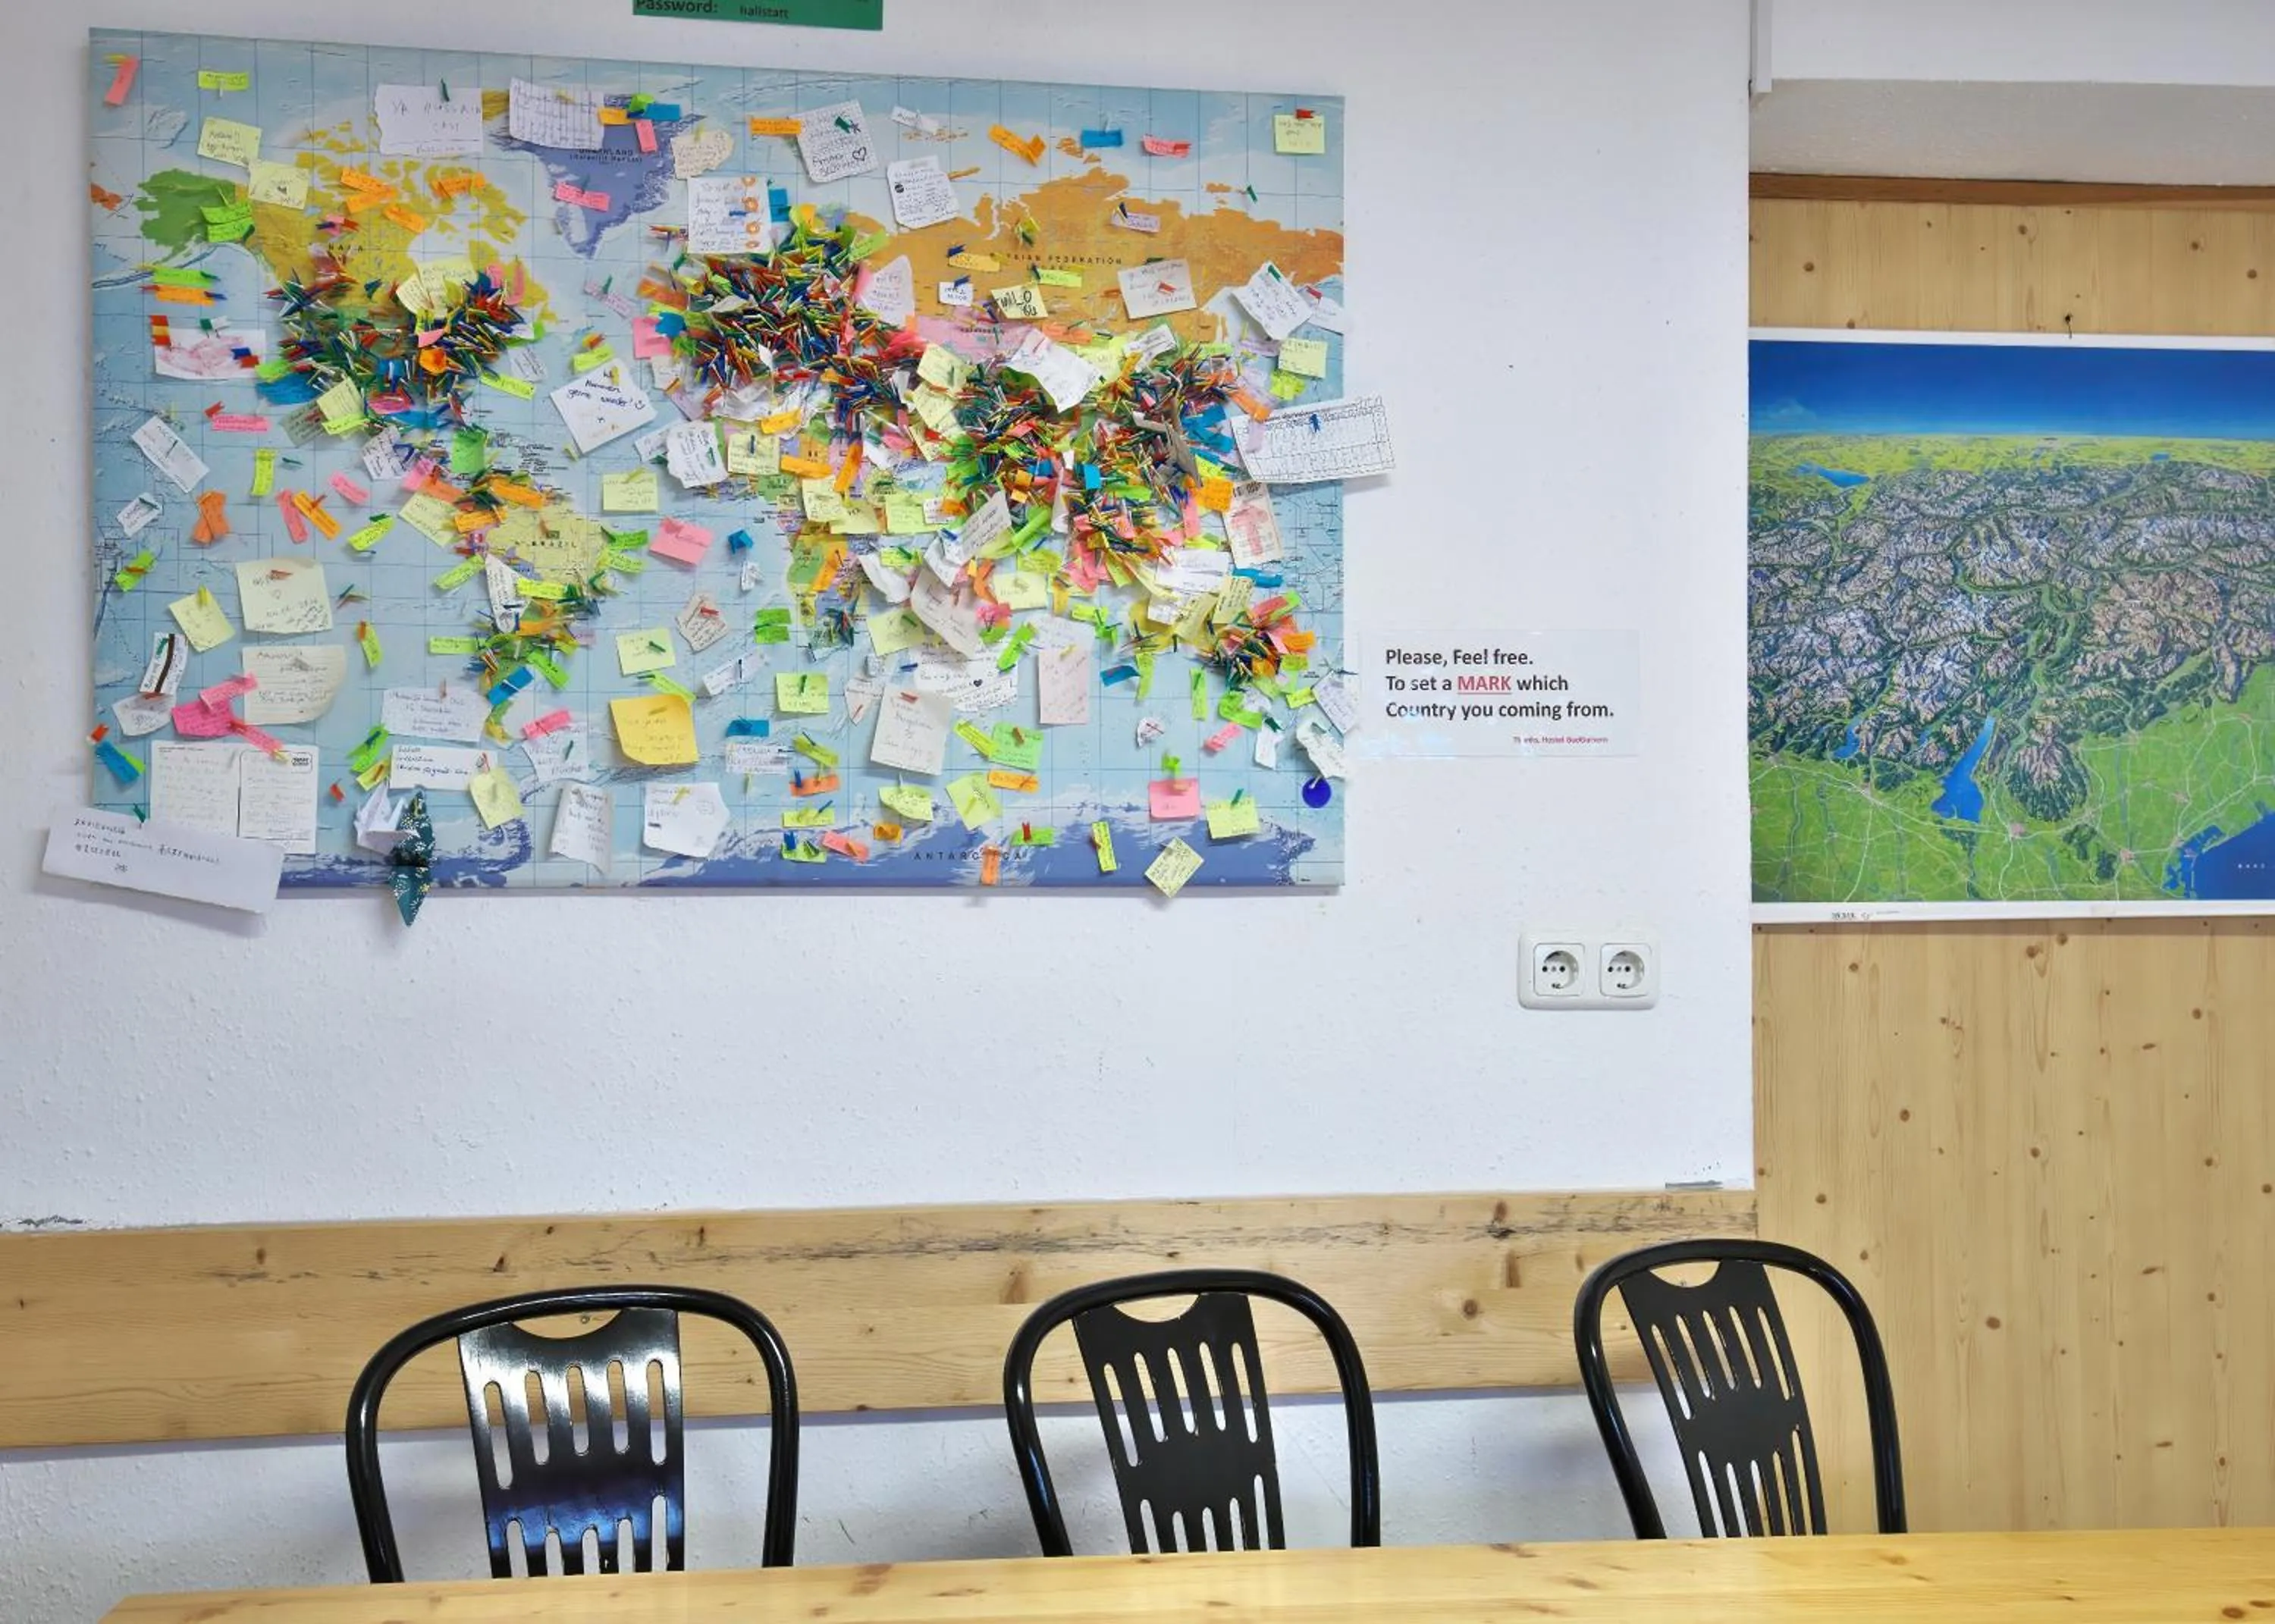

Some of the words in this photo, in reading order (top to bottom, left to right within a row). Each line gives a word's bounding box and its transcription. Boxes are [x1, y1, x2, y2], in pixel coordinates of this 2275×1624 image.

[635, 0, 717, 14] Password:
[1385, 648, 1448, 667] Please,
[1453, 648, 1489, 666] Feel
[1493, 648, 1534, 666] free.
[1385, 676, 1405, 691] To
[1410, 676, 1437, 691] set
[1442, 679, 1452, 691] a
[1457, 675, 1512, 693] MARK
[1517, 674, 1569, 691] which
[1385, 701, 1457, 721] Country
[1461, 706, 1494, 721] you
[1498, 701, 1562, 721] coming
[1566, 701, 1614, 718] from.
[913, 851, 1021, 861] ANTARCCA
